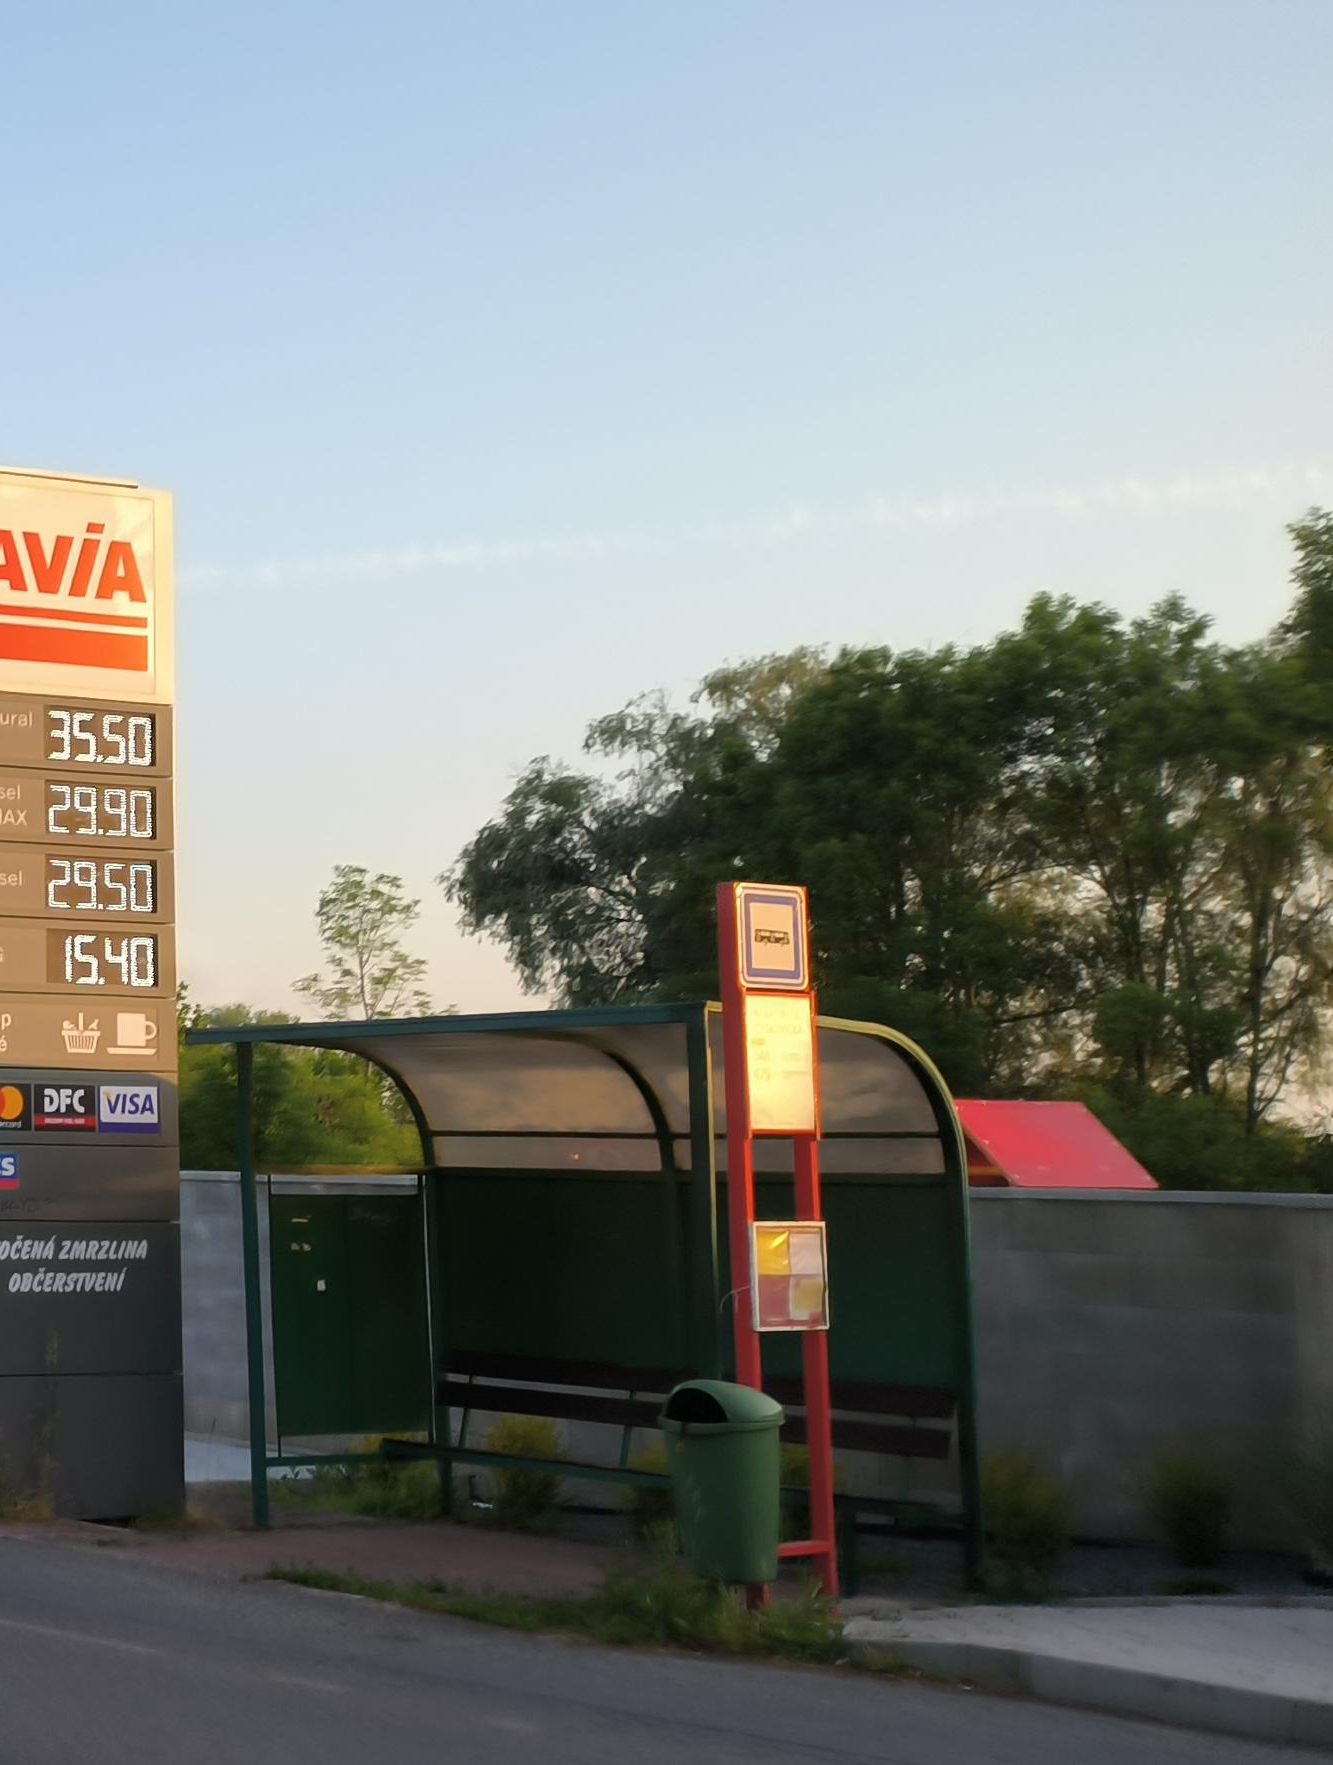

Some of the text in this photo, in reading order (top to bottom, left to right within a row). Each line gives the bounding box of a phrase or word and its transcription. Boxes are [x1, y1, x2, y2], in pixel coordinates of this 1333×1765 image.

[47, 710, 153, 766] 35.50
[48, 784, 153, 838] 29.90
[48, 859, 153, 912] 29.50
[65, 934, 154, 987] 15.40
[44, 1088, 155, 1115] DFC VISA
[58, 1239, 149, 1261] ZMRZLINA
[8, 1267, 128, 1293] OBČERSTVENÍ
